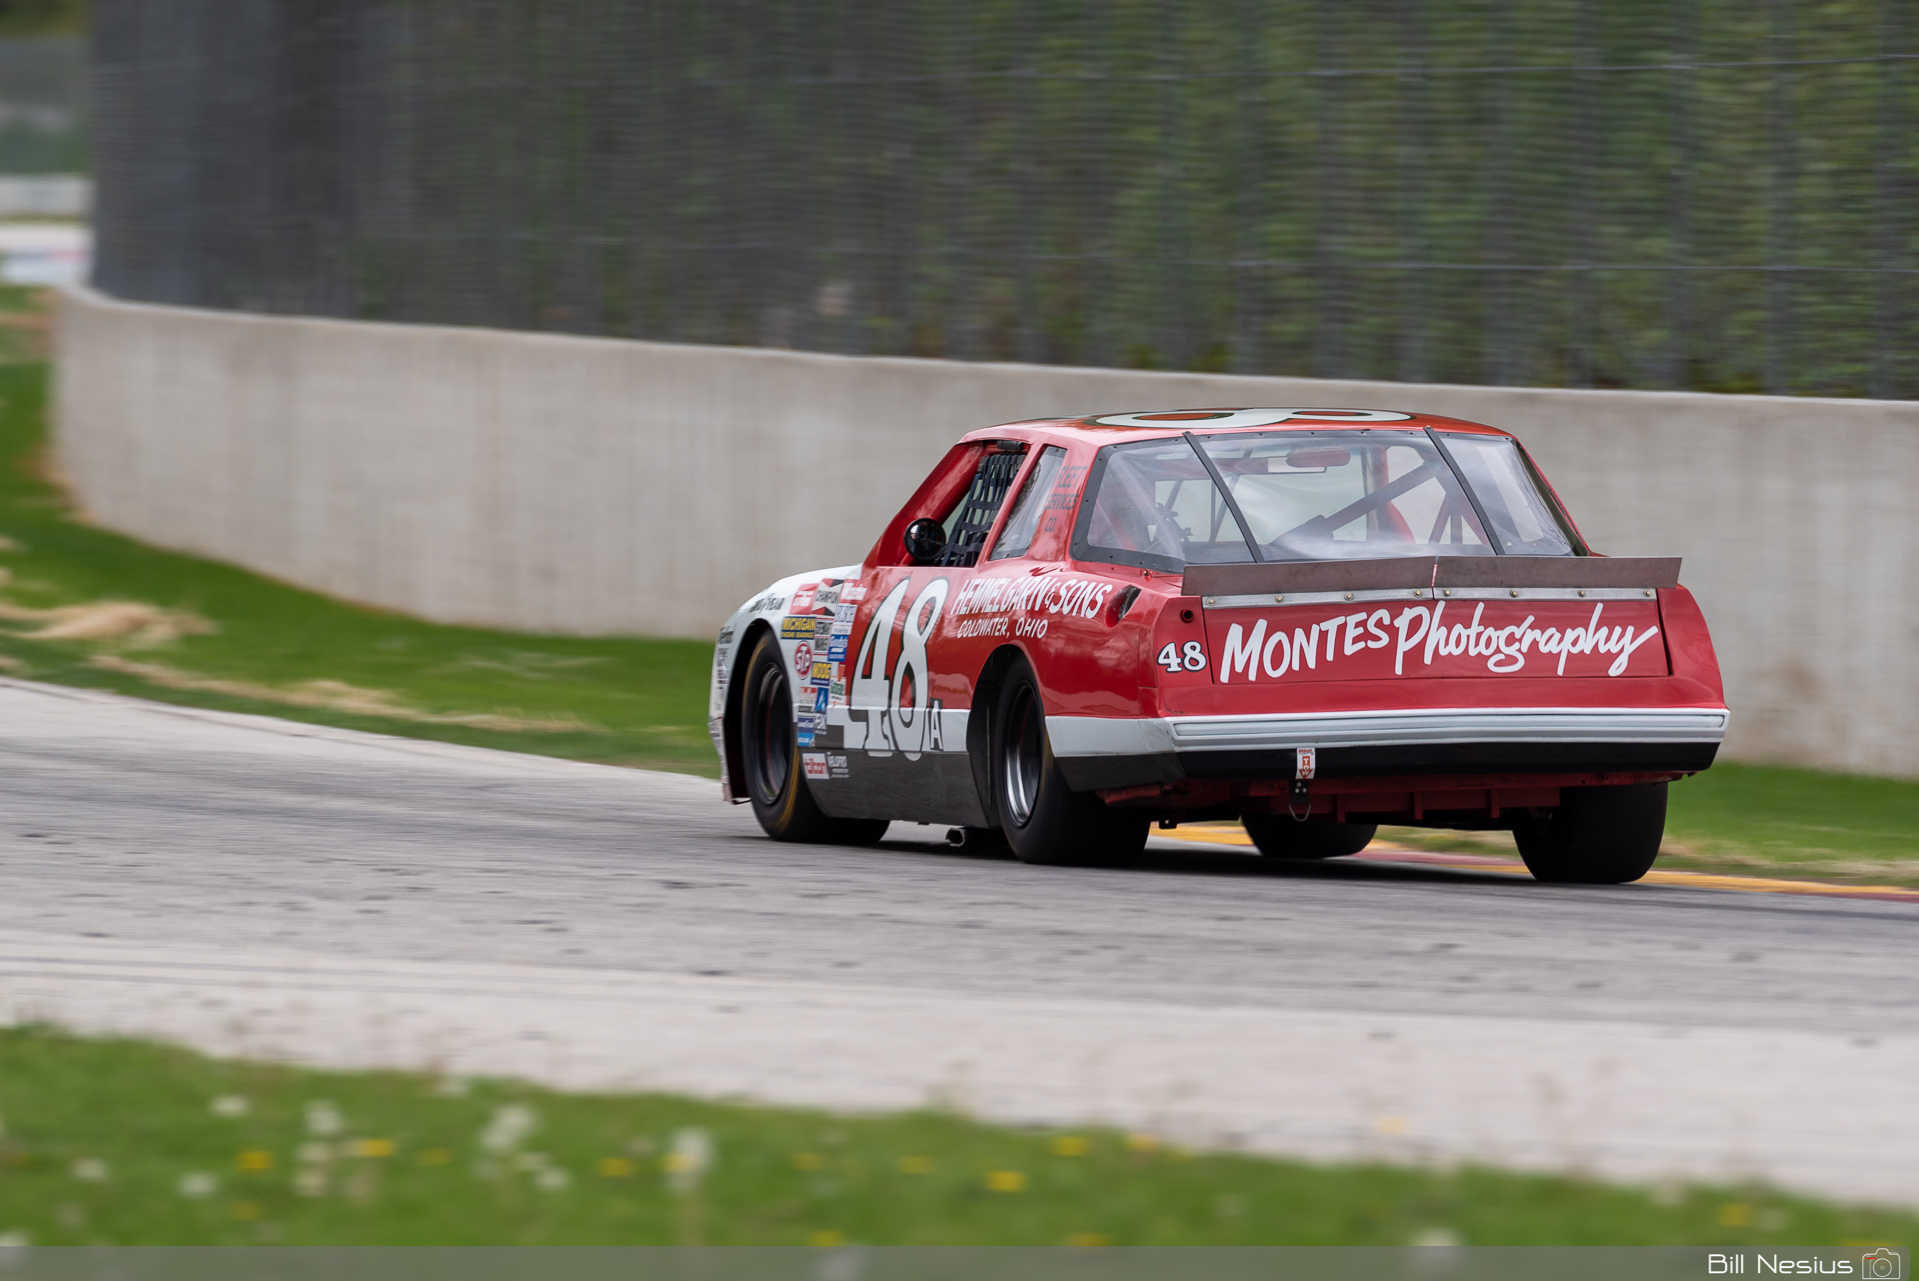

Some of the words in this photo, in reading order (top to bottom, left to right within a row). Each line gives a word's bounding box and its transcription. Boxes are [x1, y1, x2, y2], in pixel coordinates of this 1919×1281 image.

[815, 590, 840, 604] CHAMPION
[950, 576, 1057, 615] HEMMELGARN
[1050, 579, 1113, 619] SONS
[782, 617, 816, 631] MICHIGAN
[957, 617, 1010, 639] COLDWATER,
[1015, 617, 1049, 639] OHIO
[1219, 608, 1391, 684] MONTES
[1393, 600, 1659, 678] Photography
[795, 645, 811, 673] STP
[812, 663, 831, 679] MOOG
[850, 575, 950, 761] 48
[930, 698, 943, 750] A
[1157, 641, 1208, 673] 48
